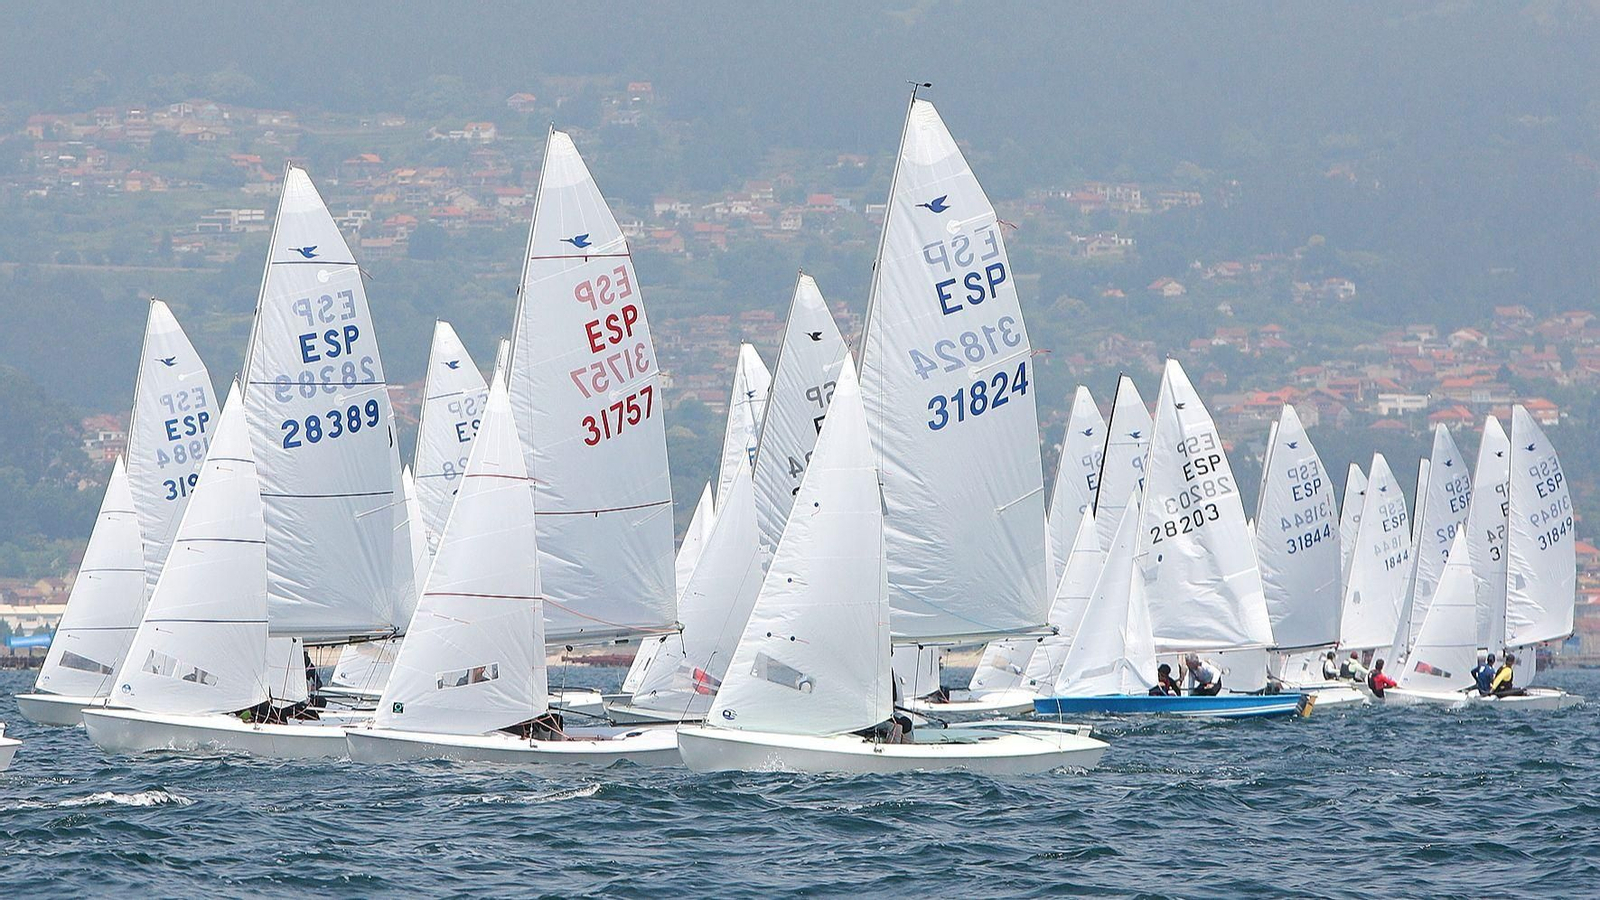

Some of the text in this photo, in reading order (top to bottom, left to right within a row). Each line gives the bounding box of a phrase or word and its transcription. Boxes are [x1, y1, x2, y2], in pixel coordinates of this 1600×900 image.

[935, 262, 1006, 315] ESP
[299, 324, 359, 363] ESP
[585, 304, 638, 354] ESP
[927, 361, 1029, 430] 31824
[165, 411, 209, 441] ESP
[281, 399, 379, 448] 28389
[582, 385, 653, 446] 31757
[1183, 454, 1221, 482] ESP
[1536, 472, 1563, 498] ESP
[1292, 478, 1322, 502] ESP
[1150, 503, 1219, 544] 28203
[1286, 523, 1330, 554] 31844
[1382, 512, 1406, 532] ESP
[1538, 516, 1573, 550] 31849
[1385, 549, 1409, 571] 1844
